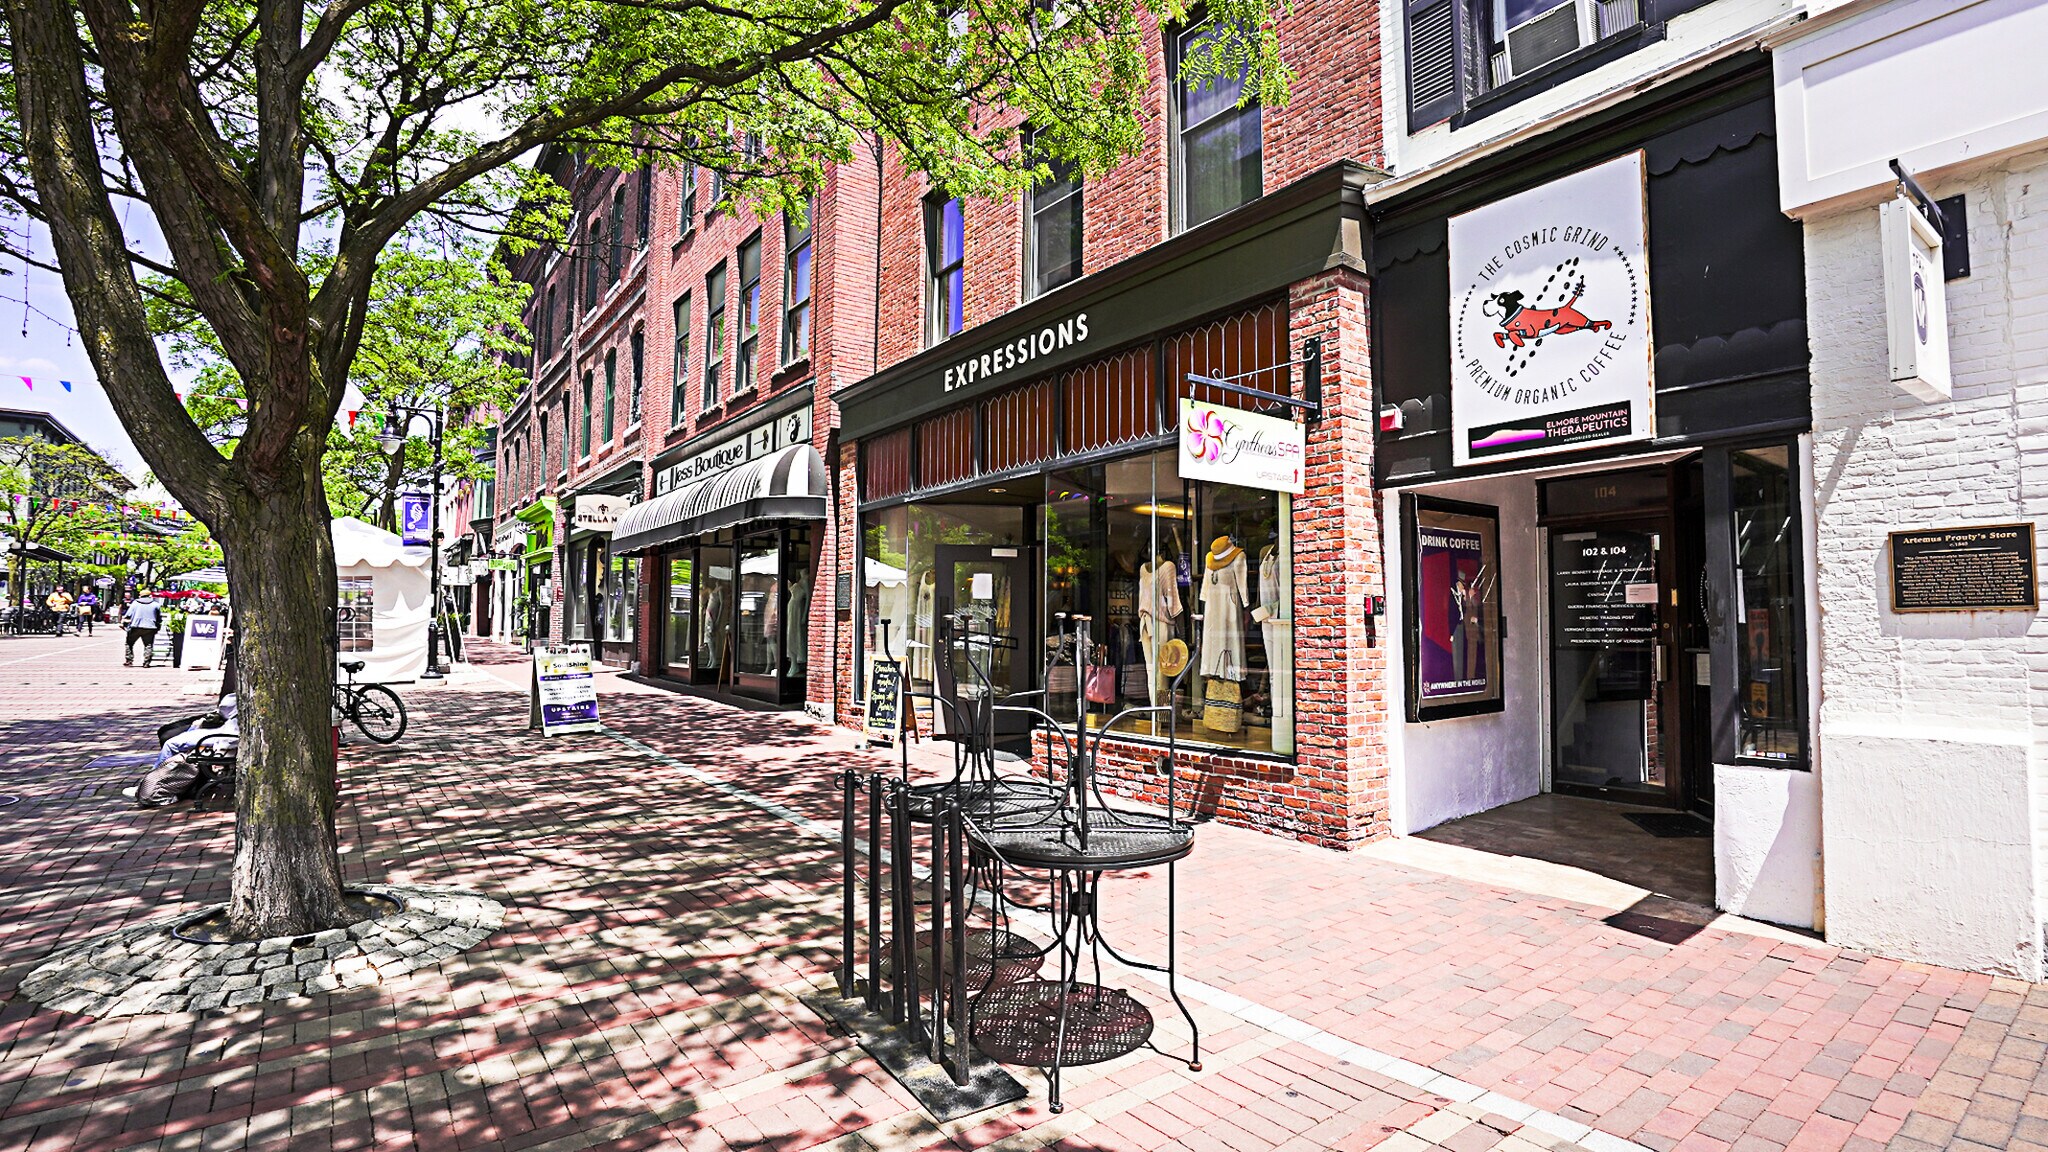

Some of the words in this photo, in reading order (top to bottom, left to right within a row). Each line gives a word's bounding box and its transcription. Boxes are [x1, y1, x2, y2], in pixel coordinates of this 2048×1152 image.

[1478, 254, 1504, 282] THE
[1504, 226, 1559, 259] COSMIC
[1563, 225, 1609, 252] GRIND
[944, 313, 1089, 392] EXPRESSIONS
[1466, 358, 1511, 402] PREMIUM
[1514, 376, 1578, 405] ORGANIC
[1583, 332, 1627, 383] COFFEE
[1546, 417, 1580, 428] ELMORE
[1582, 409, 1628, 422] MOUNTAIN
[1547, 417, 1628, 437] THERAPEUTICS
[1278, 442, 1299, 459] SPA
[694, 444, 743, 477] Boutique
[1256, 471, 1294, 483] UPSTAIRS
[1595, 486, 1616, 498] 104
[578, 514, 608, 523] STELLA
[1421, 534, 1448, 548] DRINK
[1449, 537, 1480, 550] COFFEE
[1945, 533, 1986, 542] Prouty's
[1582, 547, 1598, 557] 102
[1610, 546, 1626, 554] 104
[1430, 681, 1457, 690] ANYWHERE
